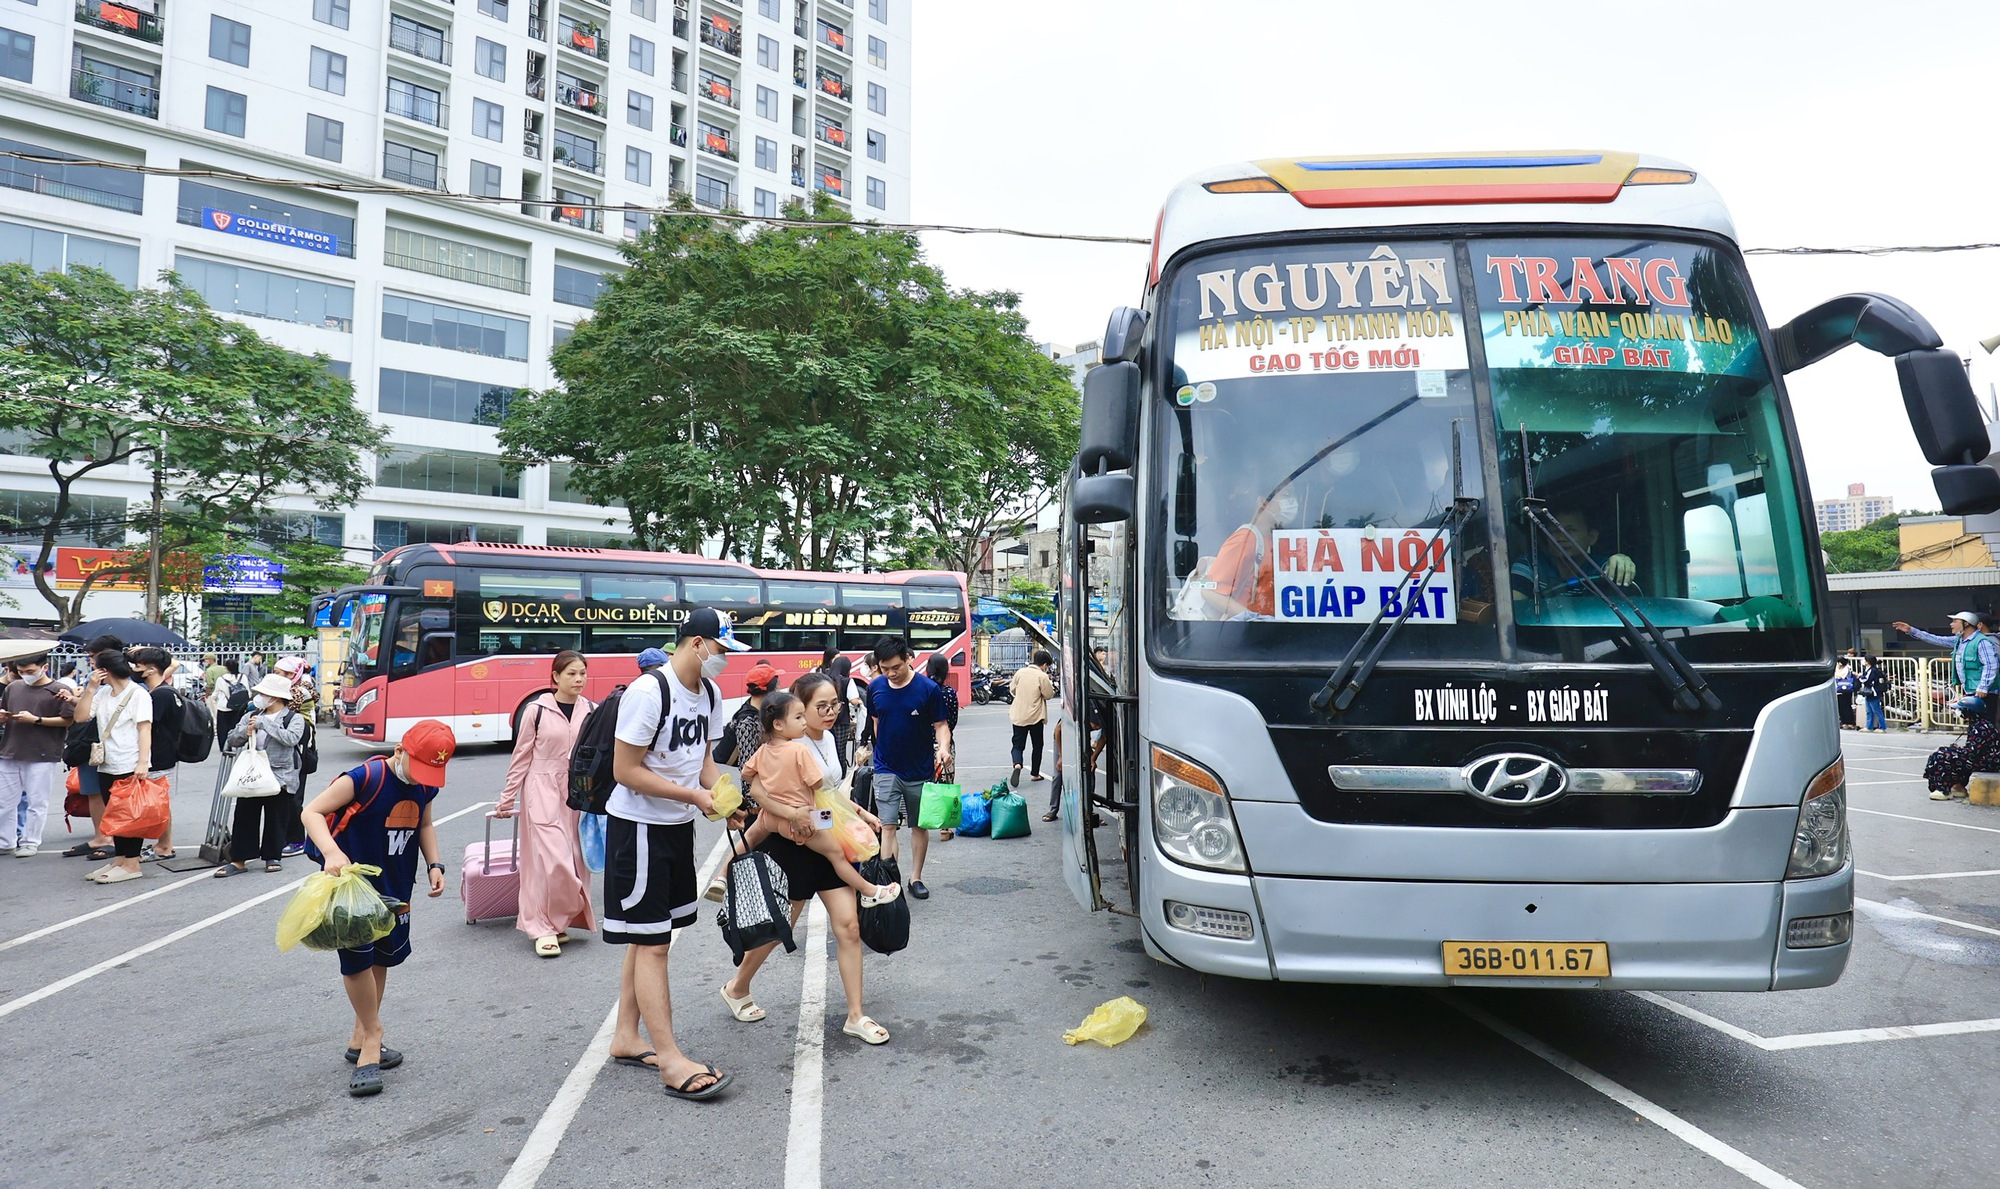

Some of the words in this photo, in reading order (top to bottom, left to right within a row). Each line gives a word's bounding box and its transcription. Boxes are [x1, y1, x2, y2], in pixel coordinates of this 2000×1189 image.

[236, 217, 287, 235] GOLDEN
[288, 228, 330, 244] ARMOR
[237, 226, 287, 241] FITNESS
[300, 239, 331, 250] YOGA
[1197, 245, 1452, 320] NGUYÊN
[1486, 254, 1691, 307] TRANG
[1199, 318, 1229, 351] HÀ
[1235, 314, 1274, 350] NỘI
[1322, 312, 1400, 342] THANH
[1406, 306, 1455, 338] HÓA
[1503, 306, 1554, 337] PHÀ
[1689, 312, 1733, 346] LÀO
[1250, 352, 1301, 372] CAO
[1309, 344, 1360, 370] TỐC
[1369, 344, 1421, 368] MỚI
[1554, 343, 1616, 366] GIÁP
[1622, 345, 1671, 367] BÁT
[1278, 530, 1344, 573] HÀ
[1360, 530, 1446, 579] NỘI
[1281, 578, 1366, 618] GIÁP
[1379, 579, 1448, 619] BÁT
[511, 602, 566, 624] DCAR
[574, 607, 624, 621] CUNG
[629, 602, 668, 624] ĐIỆN
[846, 613, 888, 626] LAN
[1414, 689, 1434, 720] BX
[1436, 682, 1469, 720] VĨNH
[1471, 682, 1497, 724] LỘC
[1527, 689, 1547, 721] BX
[1549, 684, 1580, 722] GIÁP
[1583, 682, 1609, 721] BÁT
[387, 830, 415, 856] W
[1458, 948, 1593, 970] 36B-011.67
